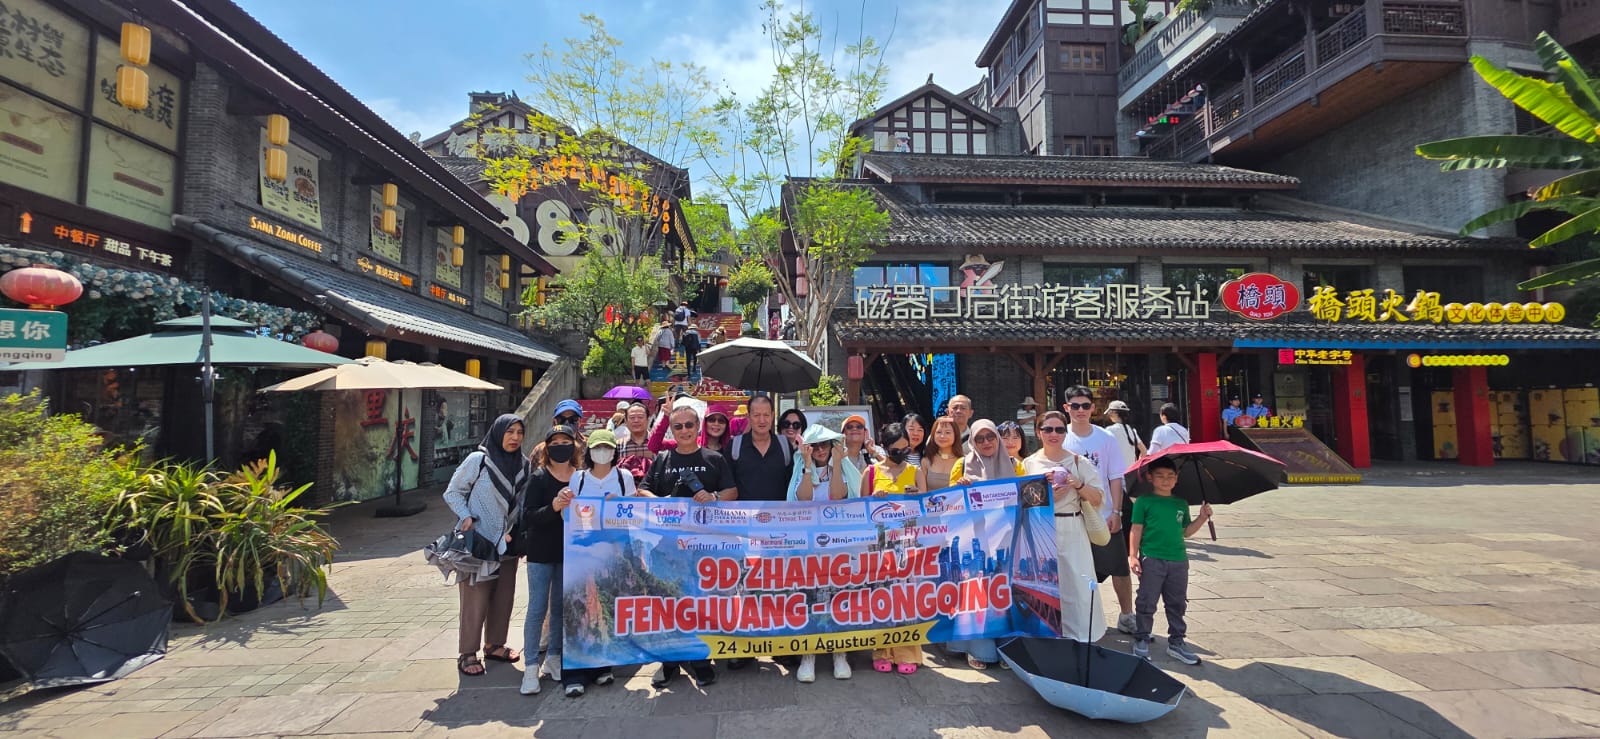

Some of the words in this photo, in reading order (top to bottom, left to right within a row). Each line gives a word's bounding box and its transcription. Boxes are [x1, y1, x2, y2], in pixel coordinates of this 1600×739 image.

[54, 225, 100, 248] 中餐厅
[104, 237, 131, 257] 甜品
[136, 246, 173, 268] 下午茶
[250, 216, 274, 235] SANA
[275, 225, 297, 243] ZOAN
[298, 234, 323, 253] COFFEE
[855, 283, 1209, 319] 磁器口后街游客服务站
[1238, 283, 1286, 310] 橋頭
[1308, 286, 1443, 324] 橋頭火鍋
[1448, 304, 1562, 321] 文化体验中心
[0, 351, 52, 360] ngqing
[657, 516, 682, 524] LUCKY
[904, 526, 920, 539] Fly
[922, 525, 947, 534] Now
[677, 537, 718, 550] Ventura
[721, 541, 742, 550] Tour
[698, 556, 739, 590] 9D
[744, 546, 940, 590] ZHANGJIAJIE
[615, 593, 809, 636] FENGHUANG
[831, 573, 1012, 625] CHONGQING
[717, 641, 737, 655] 24
[748, 640, 772, 653] Juli
[790, 639, 808, 652] 01
[815, 634, 876, 652] Agustus
[882, 629, 920, 645] 2026
